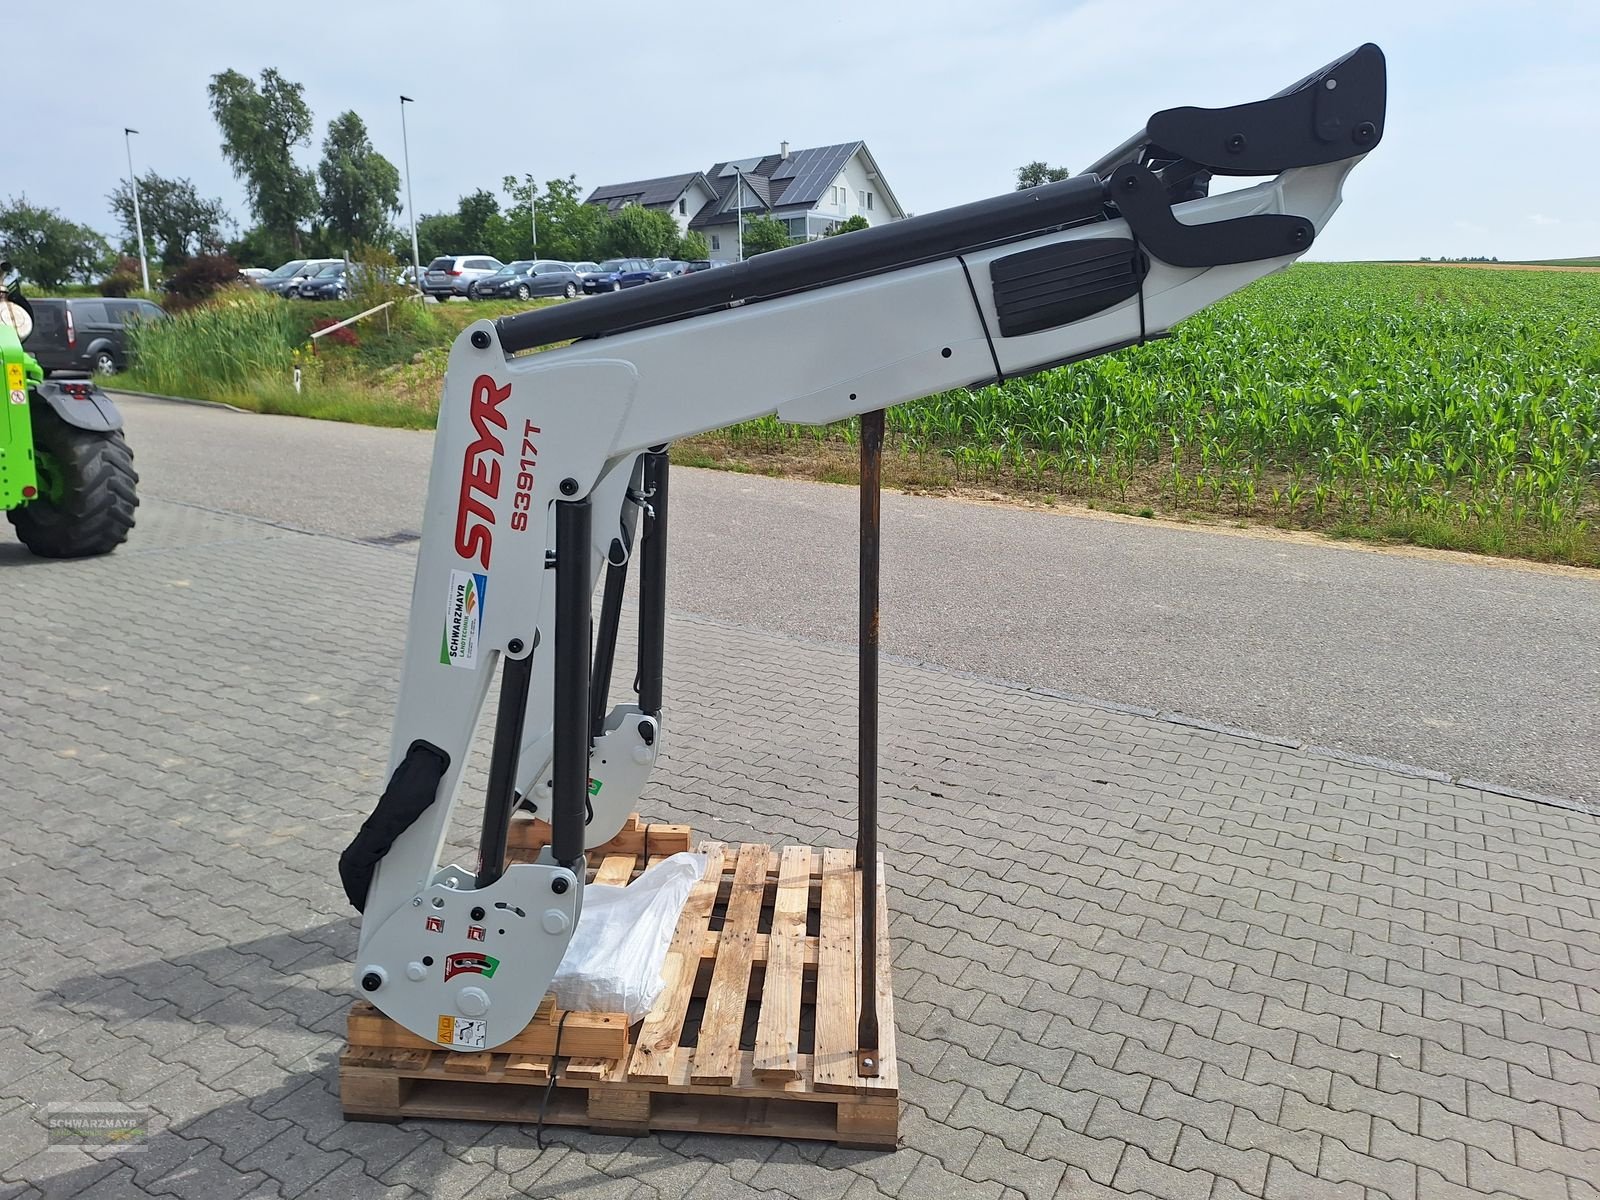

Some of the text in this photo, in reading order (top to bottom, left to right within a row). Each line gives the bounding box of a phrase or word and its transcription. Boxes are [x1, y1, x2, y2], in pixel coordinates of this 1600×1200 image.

[455, 374, 512, 570] STEYR
[511, 419, 541, 532] S3917T
[450, 584, 465, 657] SCHWARZMAYR
[459, 615, 469, 657] LANDTECHNIK
